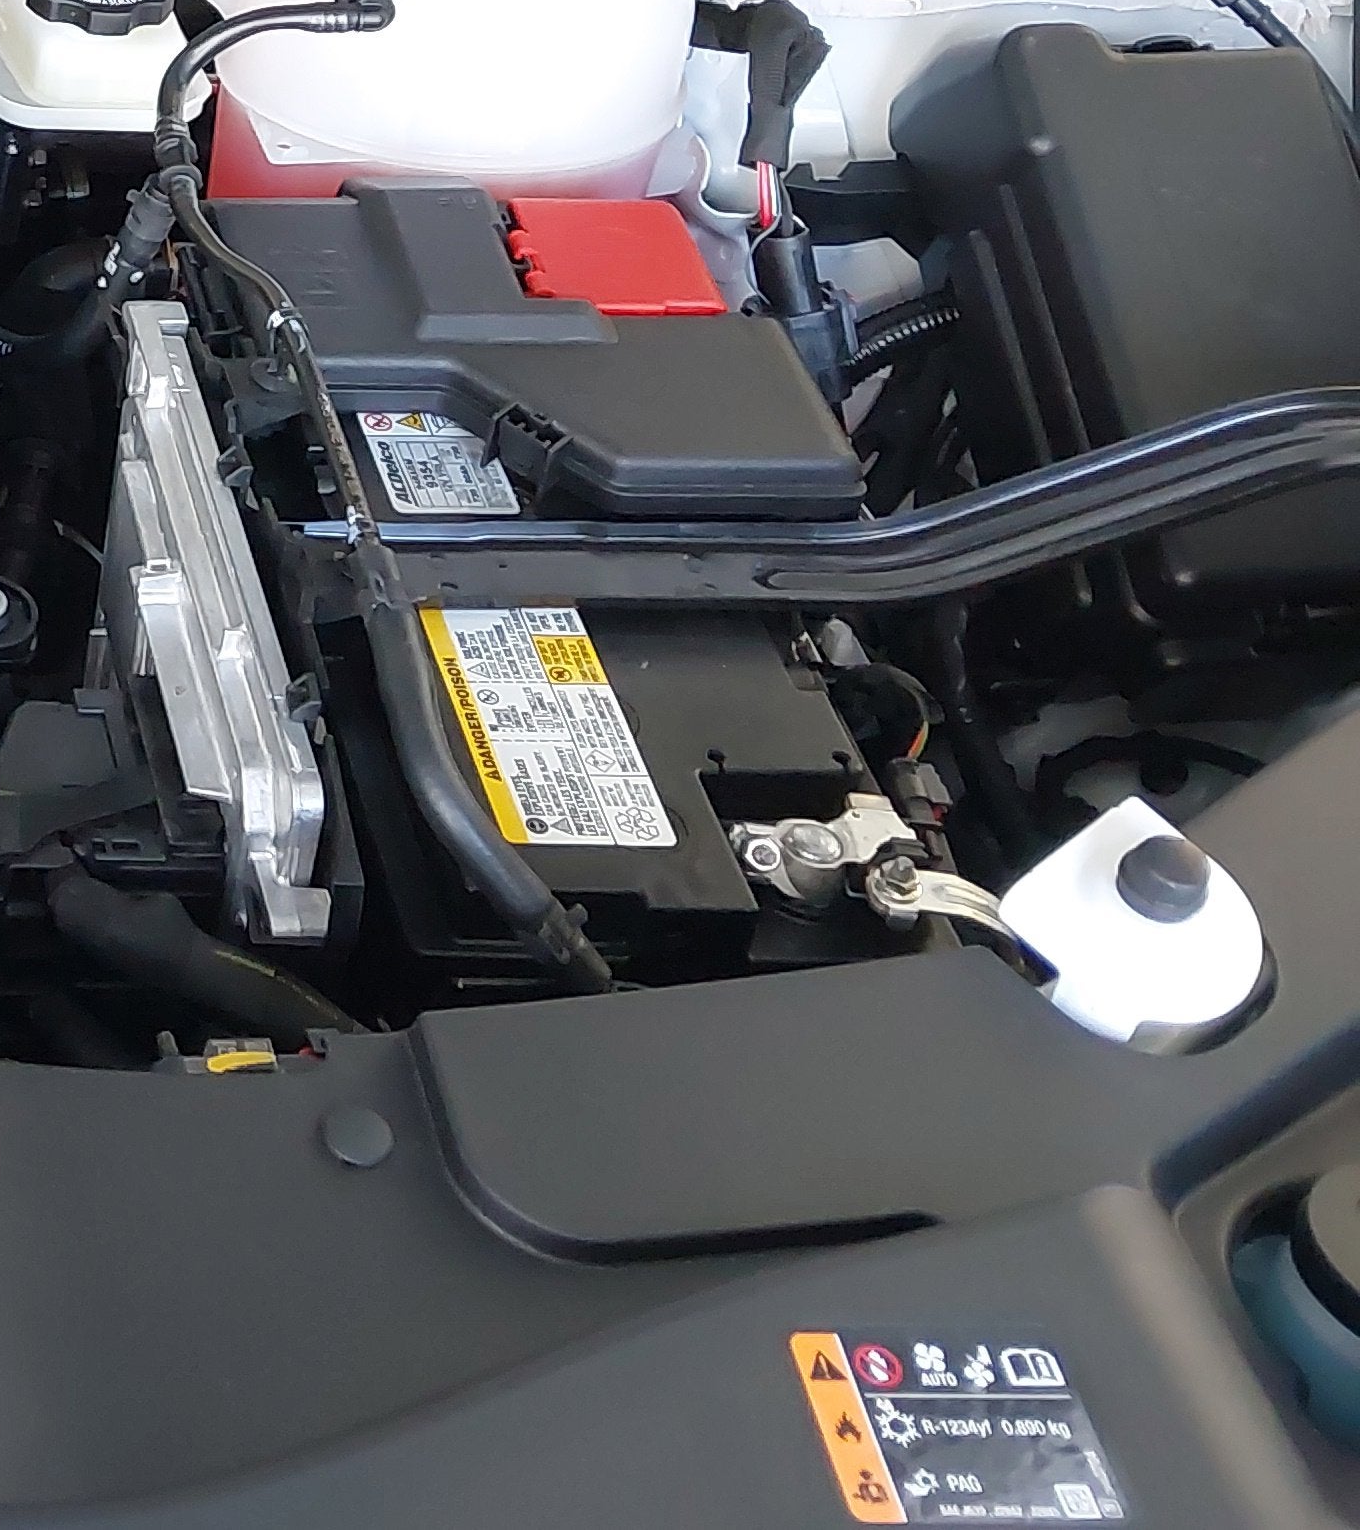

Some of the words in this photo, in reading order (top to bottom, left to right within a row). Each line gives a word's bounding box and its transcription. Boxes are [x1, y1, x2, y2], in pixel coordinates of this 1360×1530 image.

[378, 441, 411, 503] ACDelco
[444, 658, 495, 766] DANGER/POISON
[921, 1372, 958, 1387] AUTO
[923, 1419, 993, 1438] R-1234yf
[1048, 1420, 1072, 1439] kg
[945, 1473, 984, 1493] PAG
